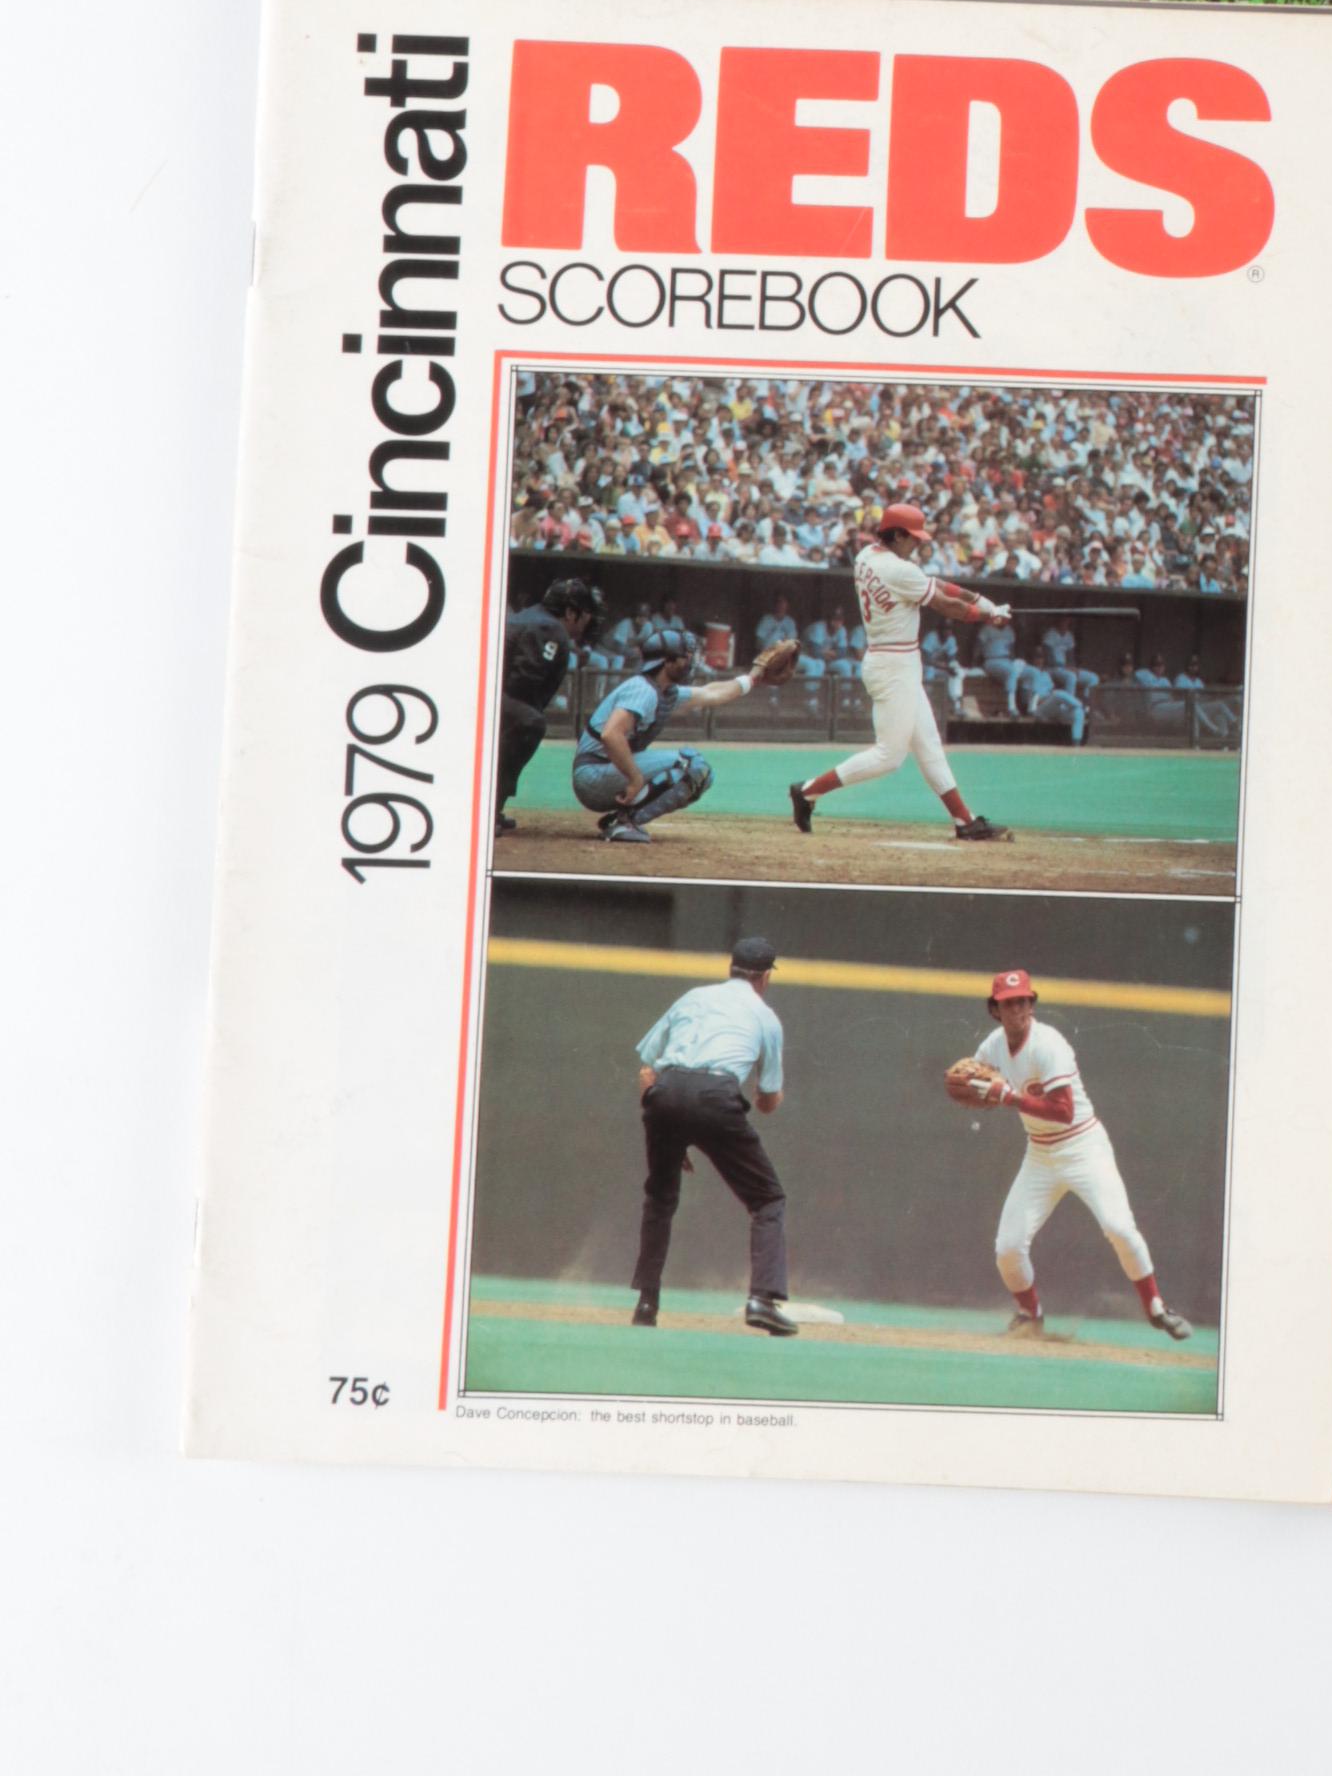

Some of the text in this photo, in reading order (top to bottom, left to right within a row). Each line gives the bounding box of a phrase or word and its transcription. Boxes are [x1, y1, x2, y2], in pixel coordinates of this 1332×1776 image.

[501, 39, 1276, 277] REDS
[497, 260, 982, 340] SCOREBOOK
[320, 33, 470, 886] 1979 Cincinnati
[328, 1376, 391, 1409] 75¢
[456, 1405, 491, 1421] Dave
[497, 1406, 582, 1424] Concepcion:
[591, 1409, 612, 1423] the
[617, 1409, 646, 1424] best
[651, 1411, 714, 1427] shortstop
[720, 1412, 732, 1426] in
